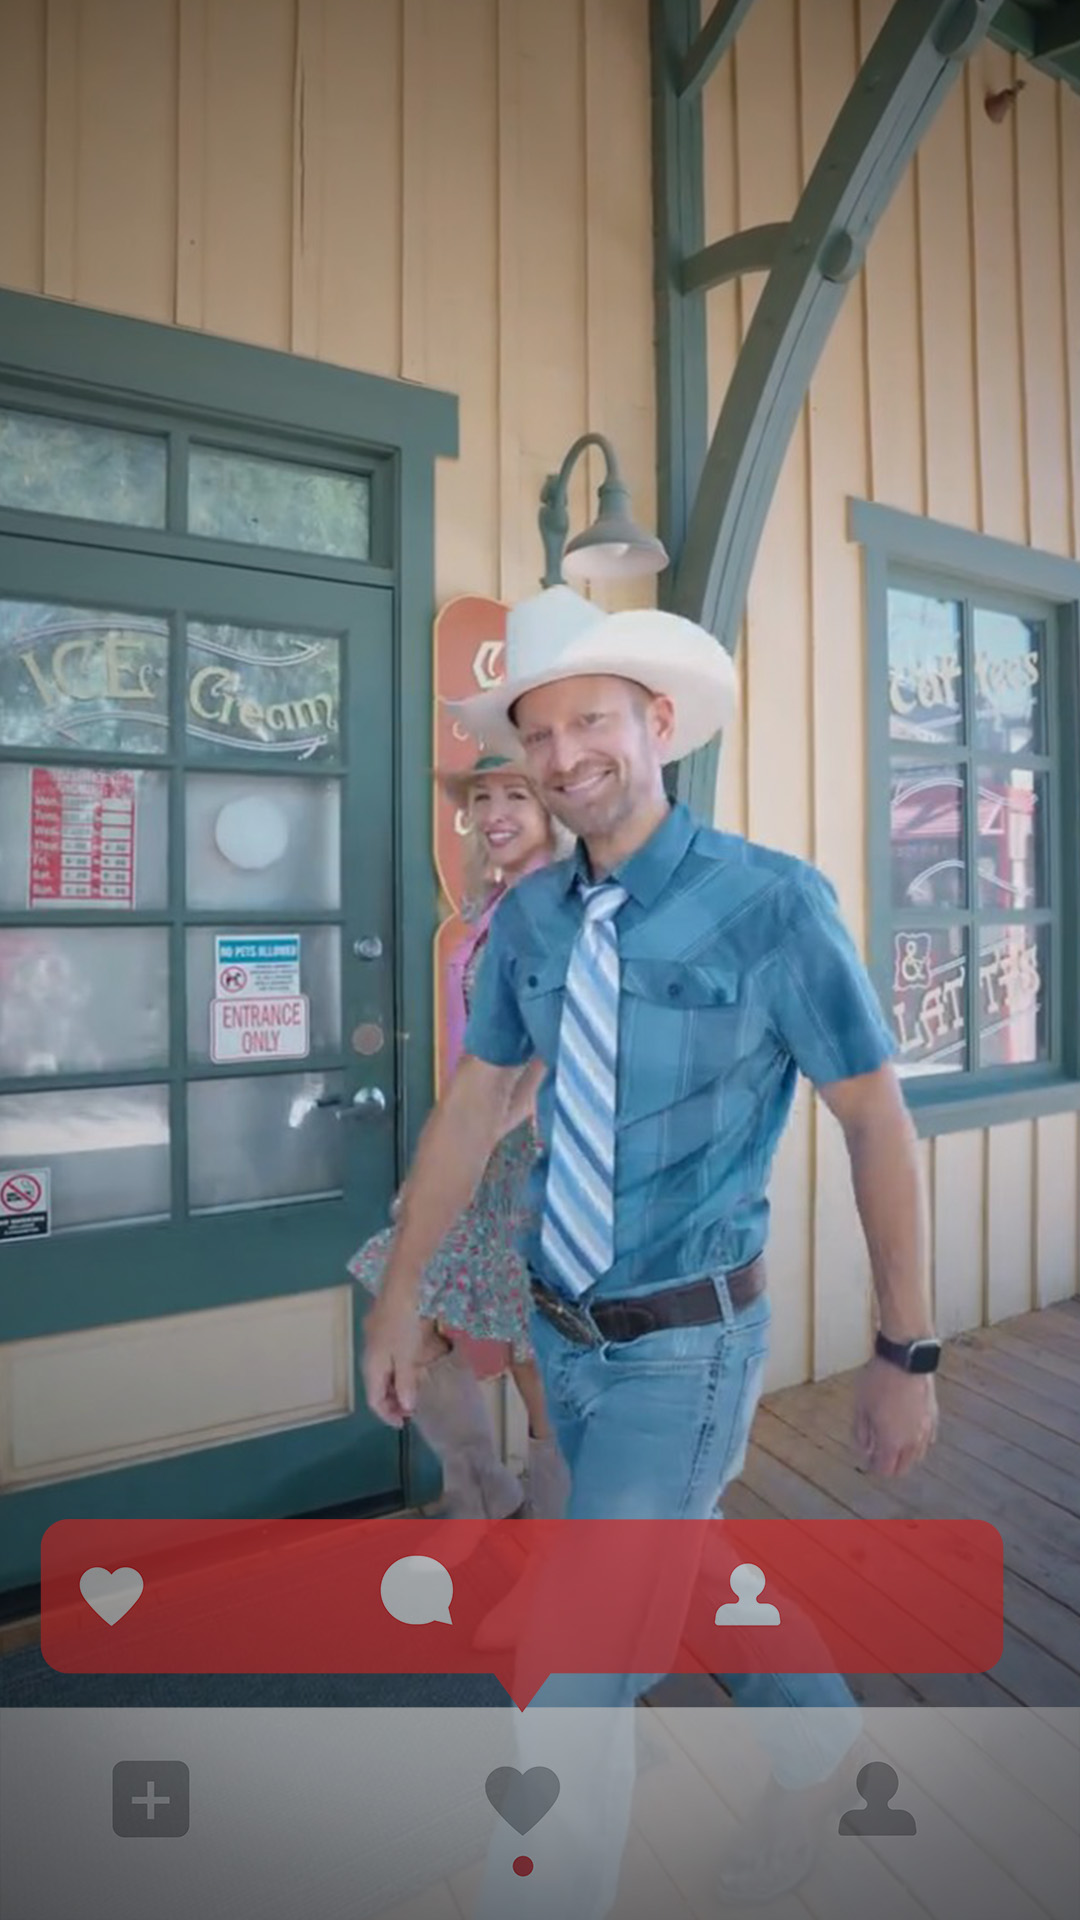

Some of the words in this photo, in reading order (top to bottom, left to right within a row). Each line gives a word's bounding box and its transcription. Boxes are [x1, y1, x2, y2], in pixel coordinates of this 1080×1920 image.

[20, 631, 156, 707] ICE
[189, 666, 338, 732] Cream
[902, 941, 925, 980] &
[223, 1002, 301, 1029] ENTRANCE
[242, 1030, 279, 1054] ONLY
